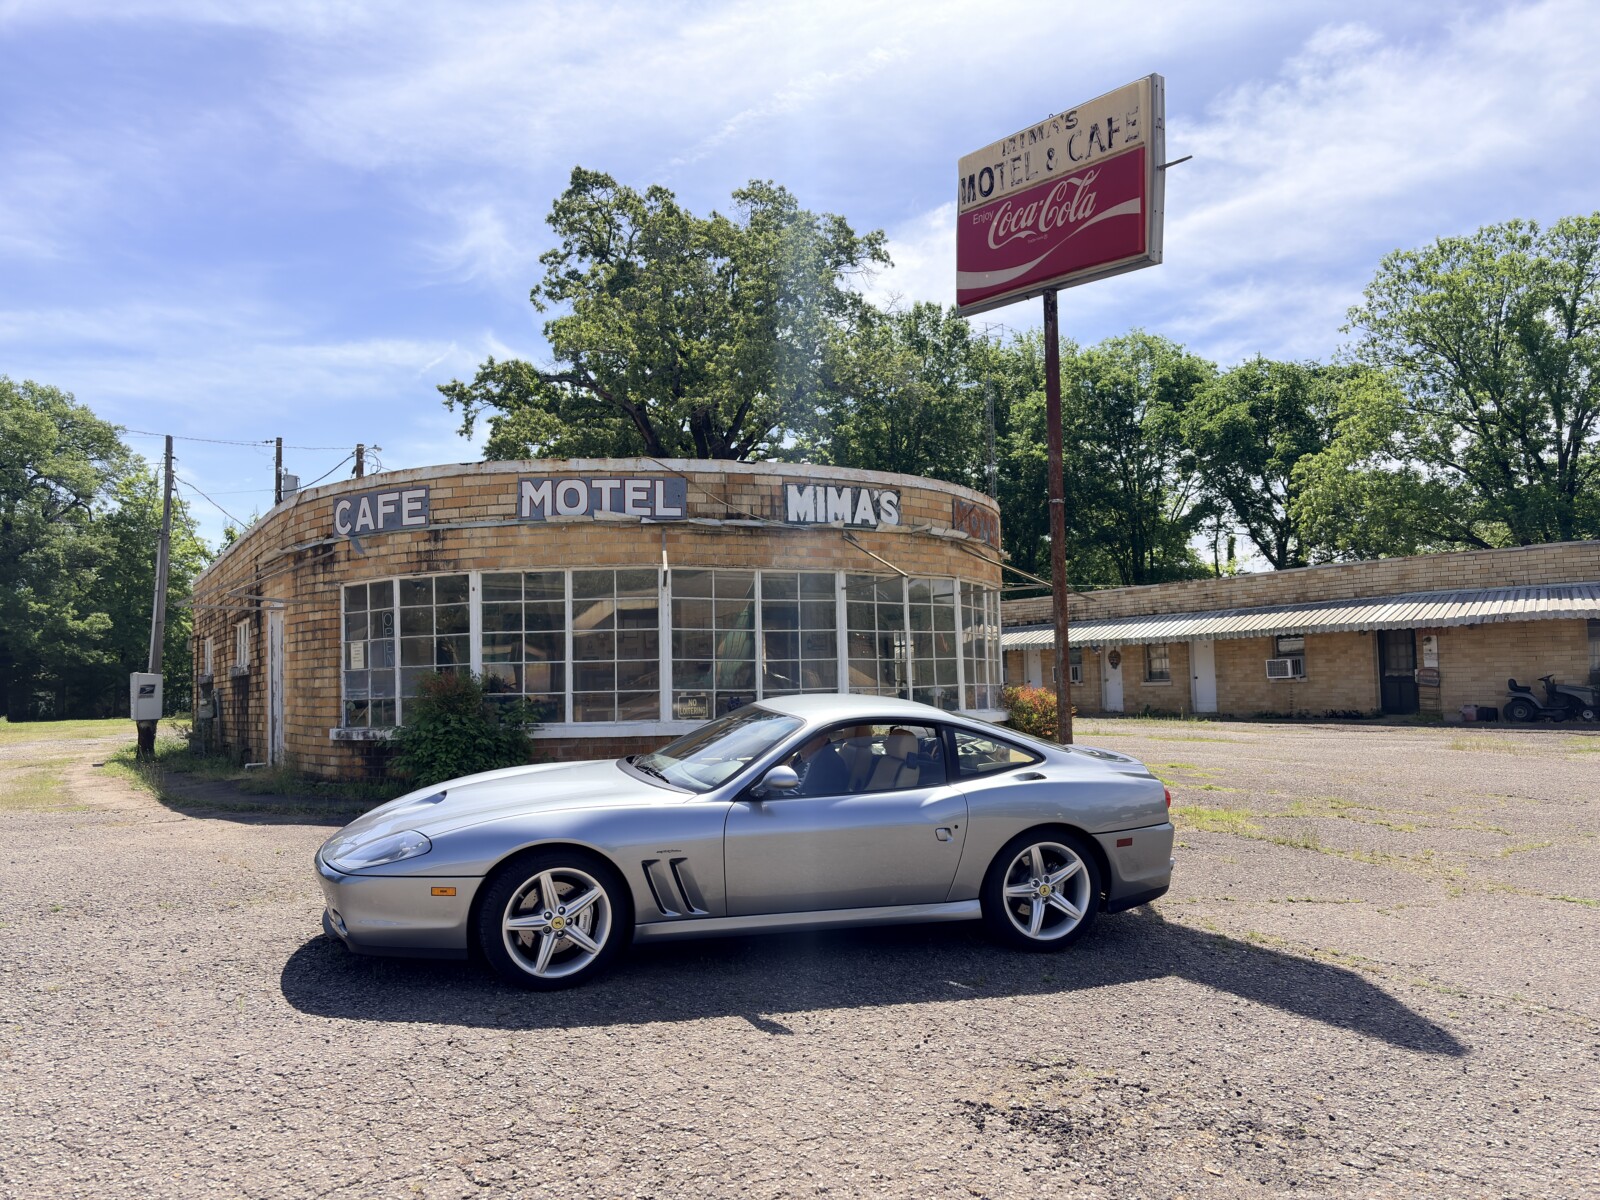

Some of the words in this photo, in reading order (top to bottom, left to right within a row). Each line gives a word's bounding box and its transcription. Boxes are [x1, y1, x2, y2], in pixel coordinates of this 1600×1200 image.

[960, 147, 1039, 206] MOTEL
[1046, 147, 1058, 171] &
[1068, 105, 1140, 162] CAFE
[972, 209, 995, 225] Enjoy
[987, 167, 1102, 249] Coca-Cola
[334, 488, 427, 535] CAFE
[520, 478, 683, 518] MOTEL
[786, 483, 901, 527] MIMA'S
[383, 613, 394, 667] OPEN
[679, 706, 706, 715] LOITERING
[688, 698, 697, 706] NO
